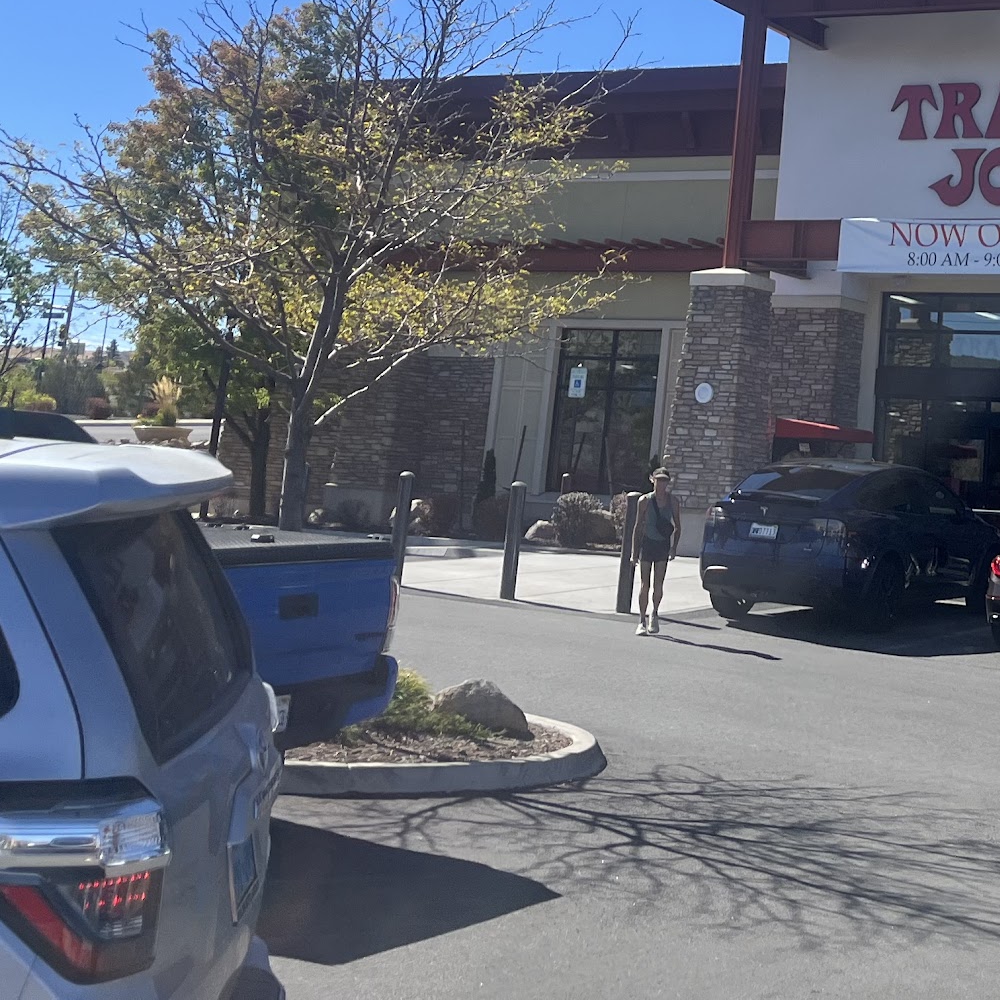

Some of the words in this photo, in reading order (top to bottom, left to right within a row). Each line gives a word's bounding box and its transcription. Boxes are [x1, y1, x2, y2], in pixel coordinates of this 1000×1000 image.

[888, 221, 968, 248] NOW
[907, 252, 937, 267] 8:00
[941, 252, 970, 268] AM
